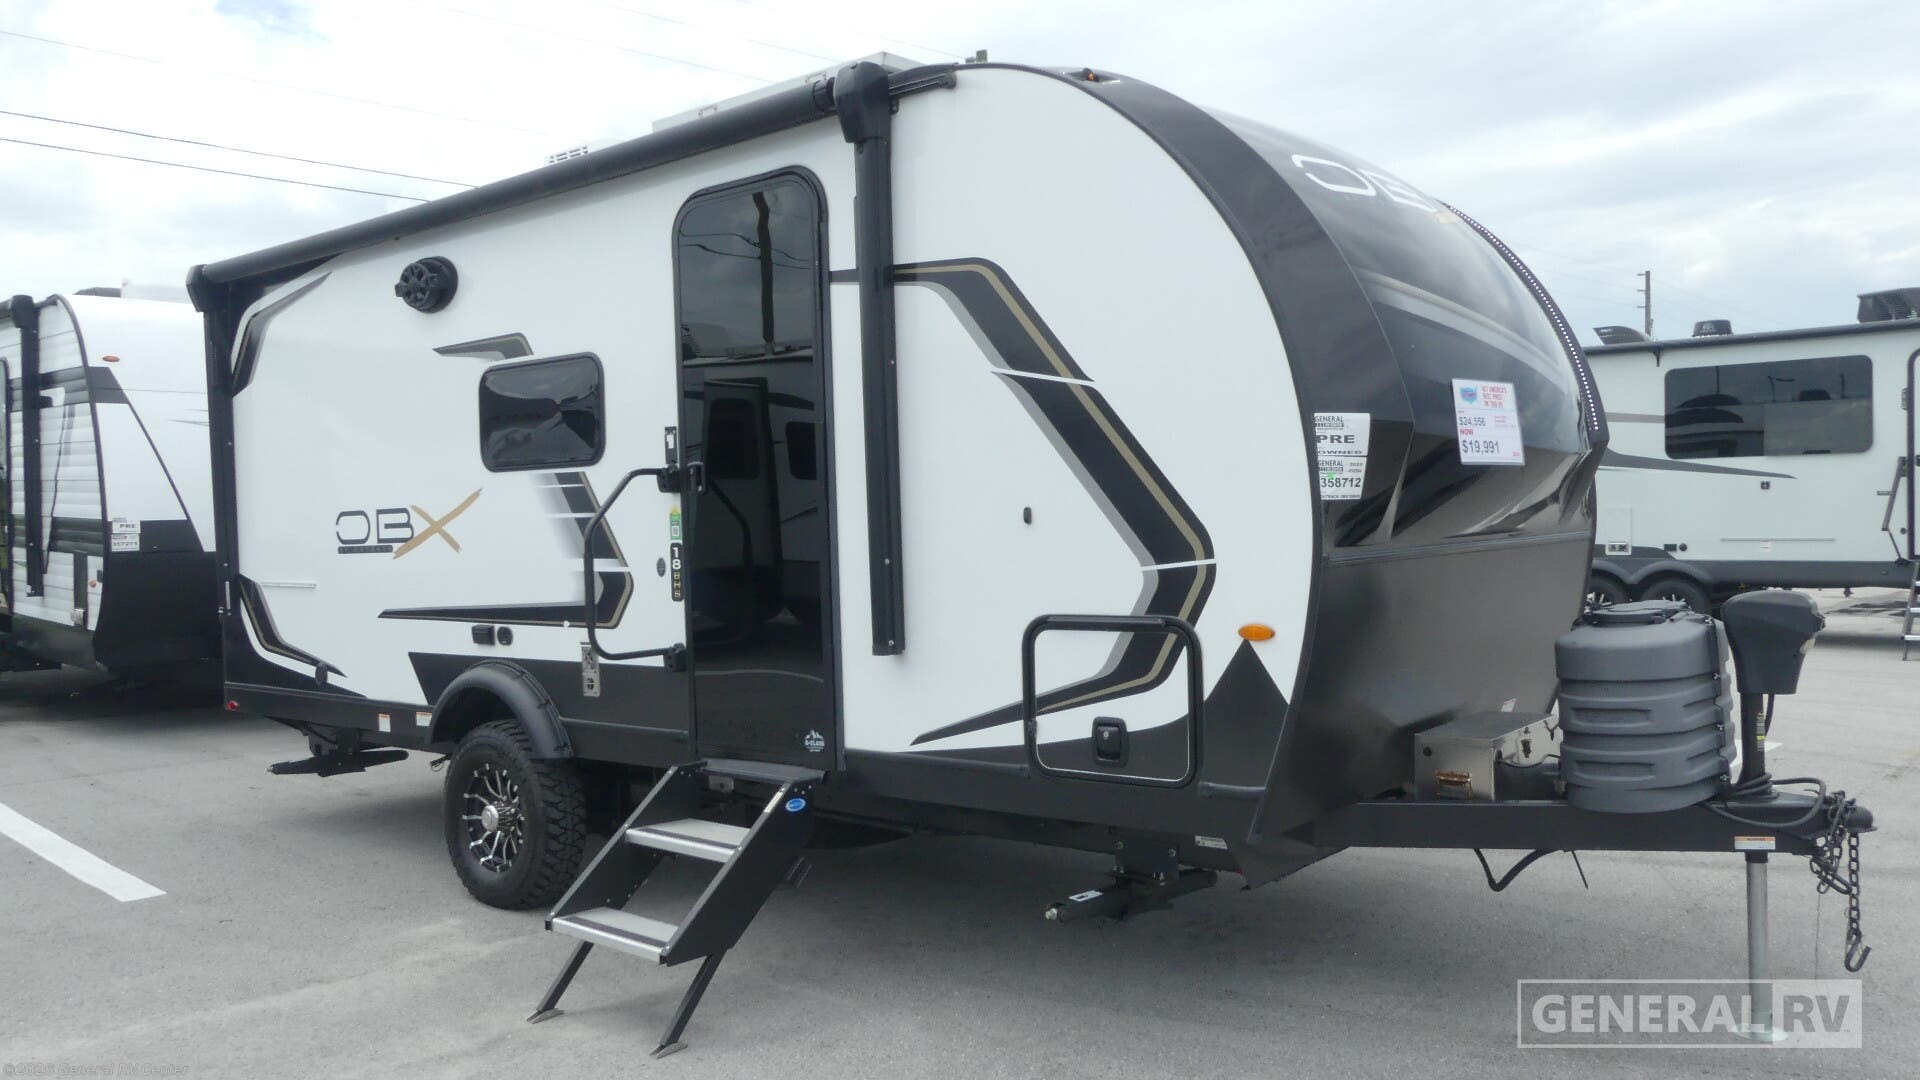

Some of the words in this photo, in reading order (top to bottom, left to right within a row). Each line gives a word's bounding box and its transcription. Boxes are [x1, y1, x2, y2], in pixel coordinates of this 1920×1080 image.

[1291, 154, 1455, 224] OB
[1316, 434, 1355, 444] PRE
[1462, 440, 1500, 455] $19,991
[1320, 477, 1362, 488] 358712
[336, 488, 482, 560] OBX
